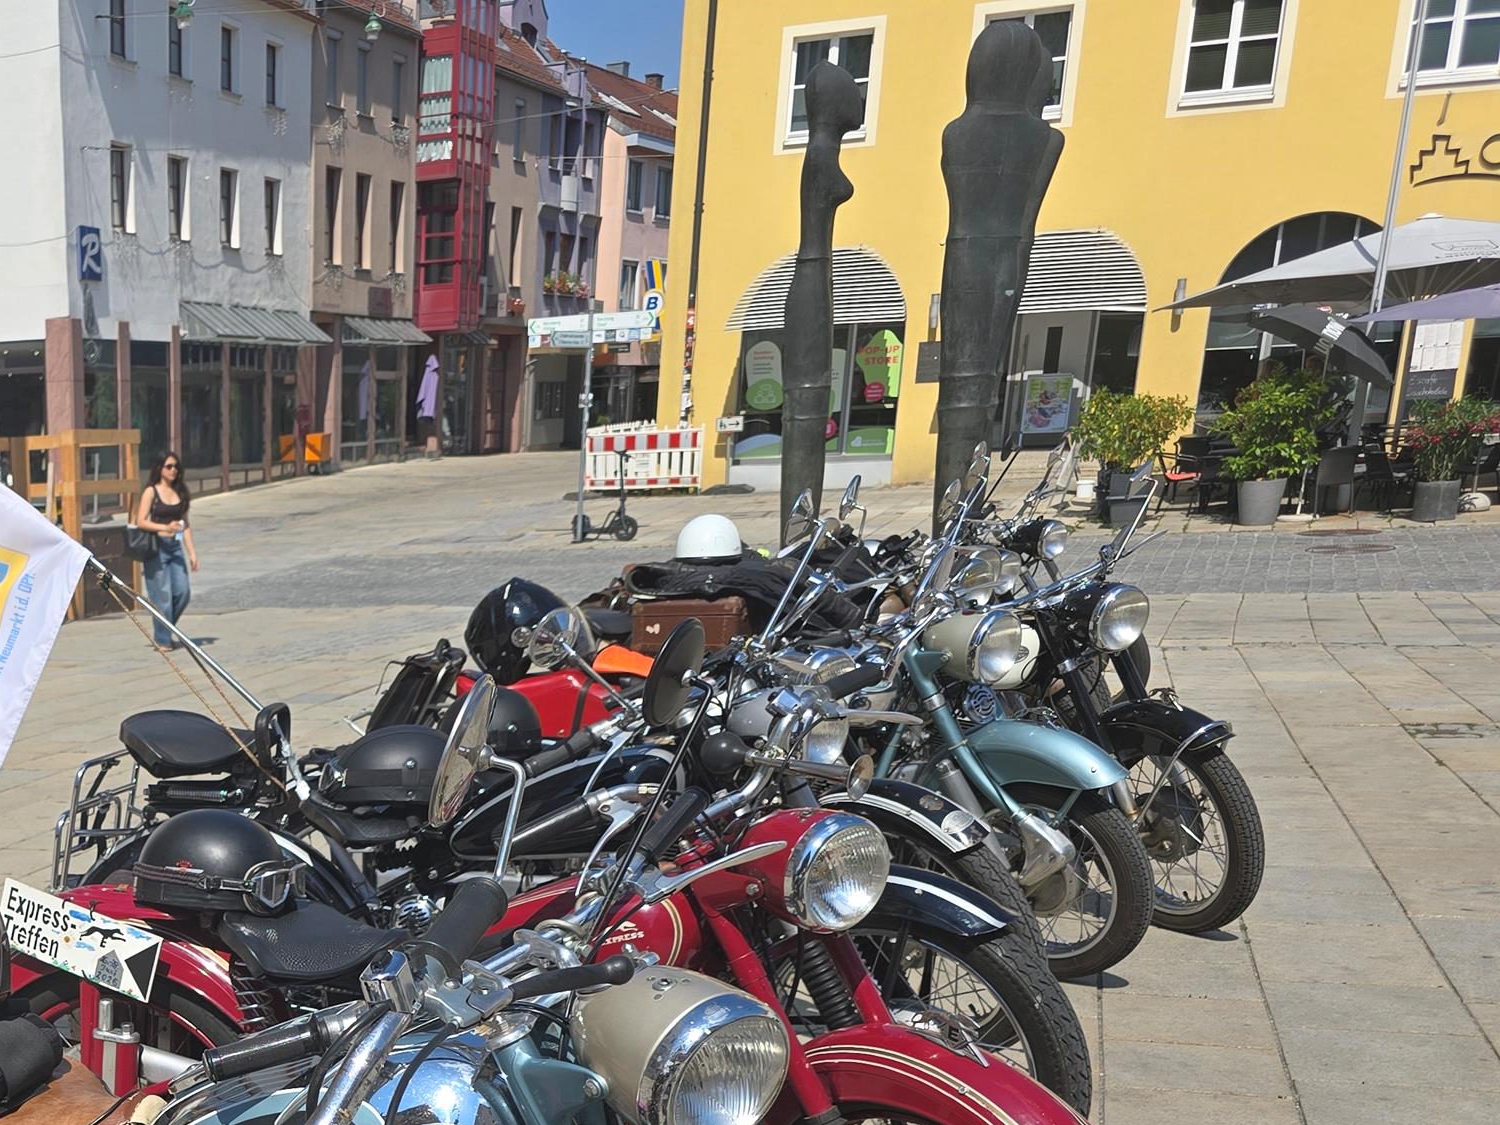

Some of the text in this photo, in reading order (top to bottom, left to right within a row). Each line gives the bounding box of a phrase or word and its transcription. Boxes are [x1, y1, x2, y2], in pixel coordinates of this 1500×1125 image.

[81, 233, 101, 274] R
[646, 296, 659, 310] B
[864, 356, 899, 365] STORE
[7, 887, 77, 932] Express-
[4, 914, 59, 959] Treffen
[600, 931, 645, 946] XPRESS
